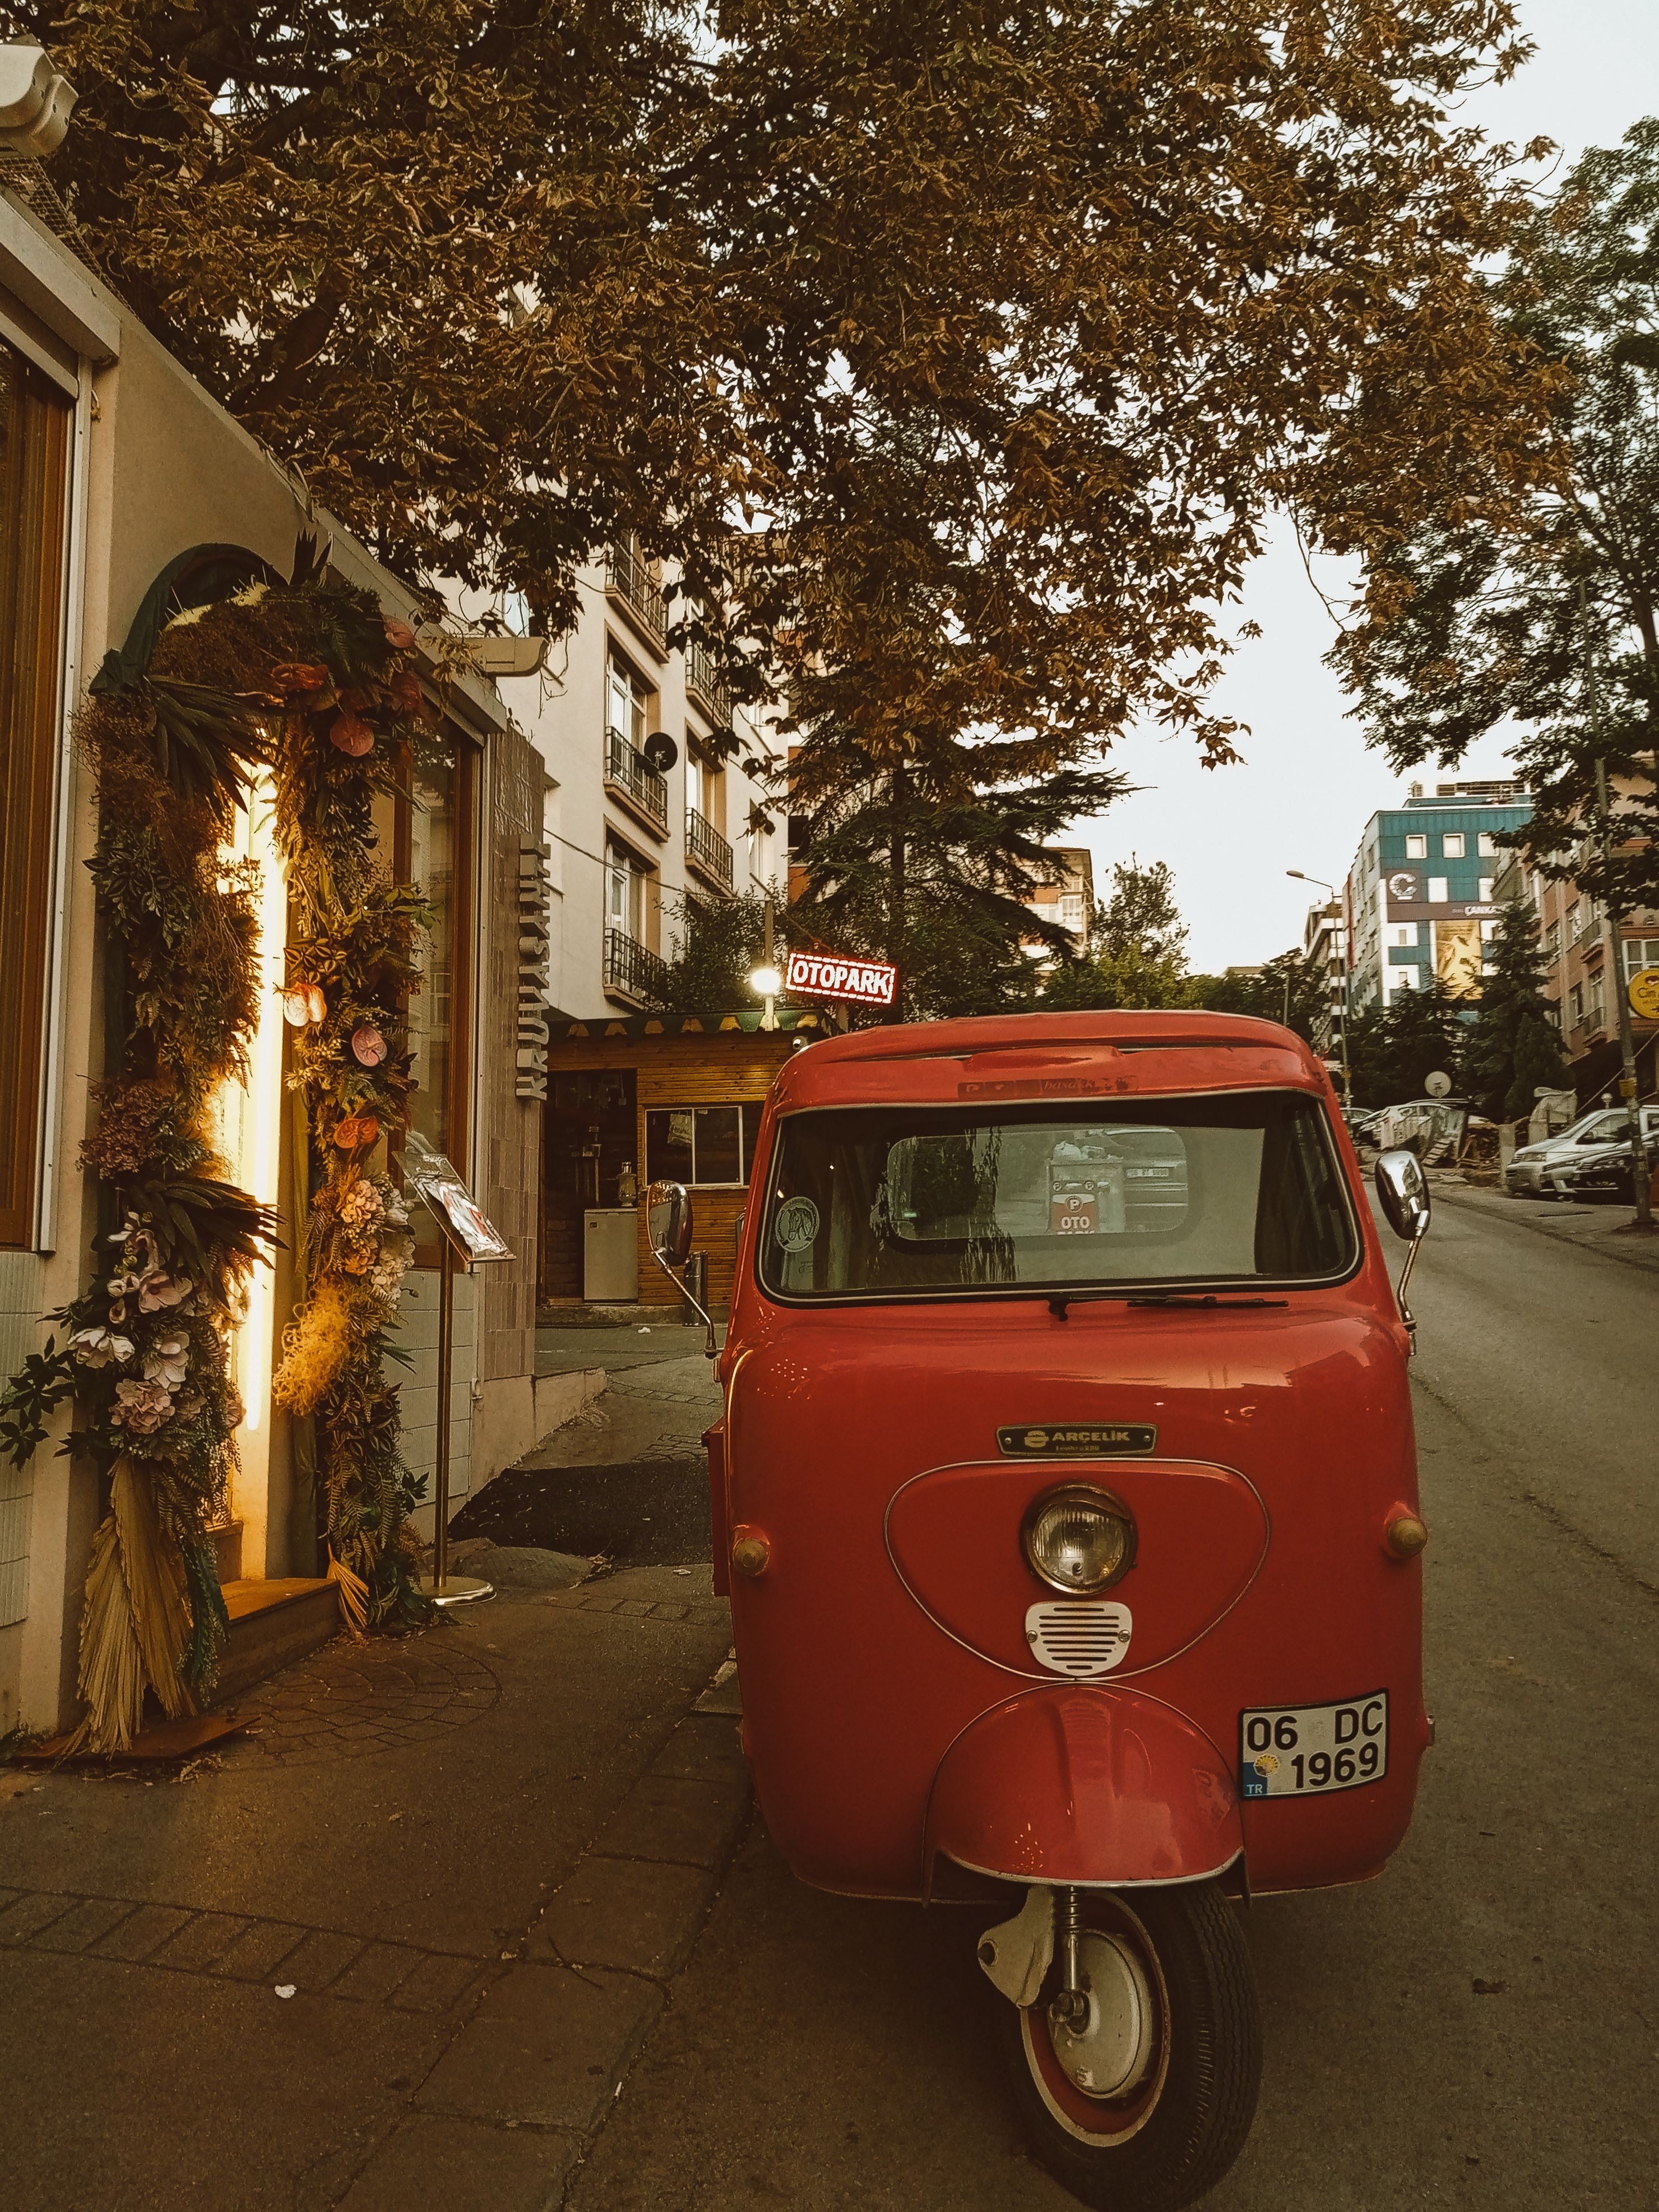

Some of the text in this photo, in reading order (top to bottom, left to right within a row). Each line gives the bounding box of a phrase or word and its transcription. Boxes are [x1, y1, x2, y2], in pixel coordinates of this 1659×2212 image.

[792, 960, 891, 996] OTOPARK
[1070, 1198, 1080, 1210] P
[1060, 1215, 1091, 1229] OTO
[1051, 1430, 1130, 1443] ARÇELİK
[1247, 1701, 1383, 1752] 06 DC
[1291, 1742, 1379, 1788] 1969
[1246, 1784, 1263, 1794] TR
